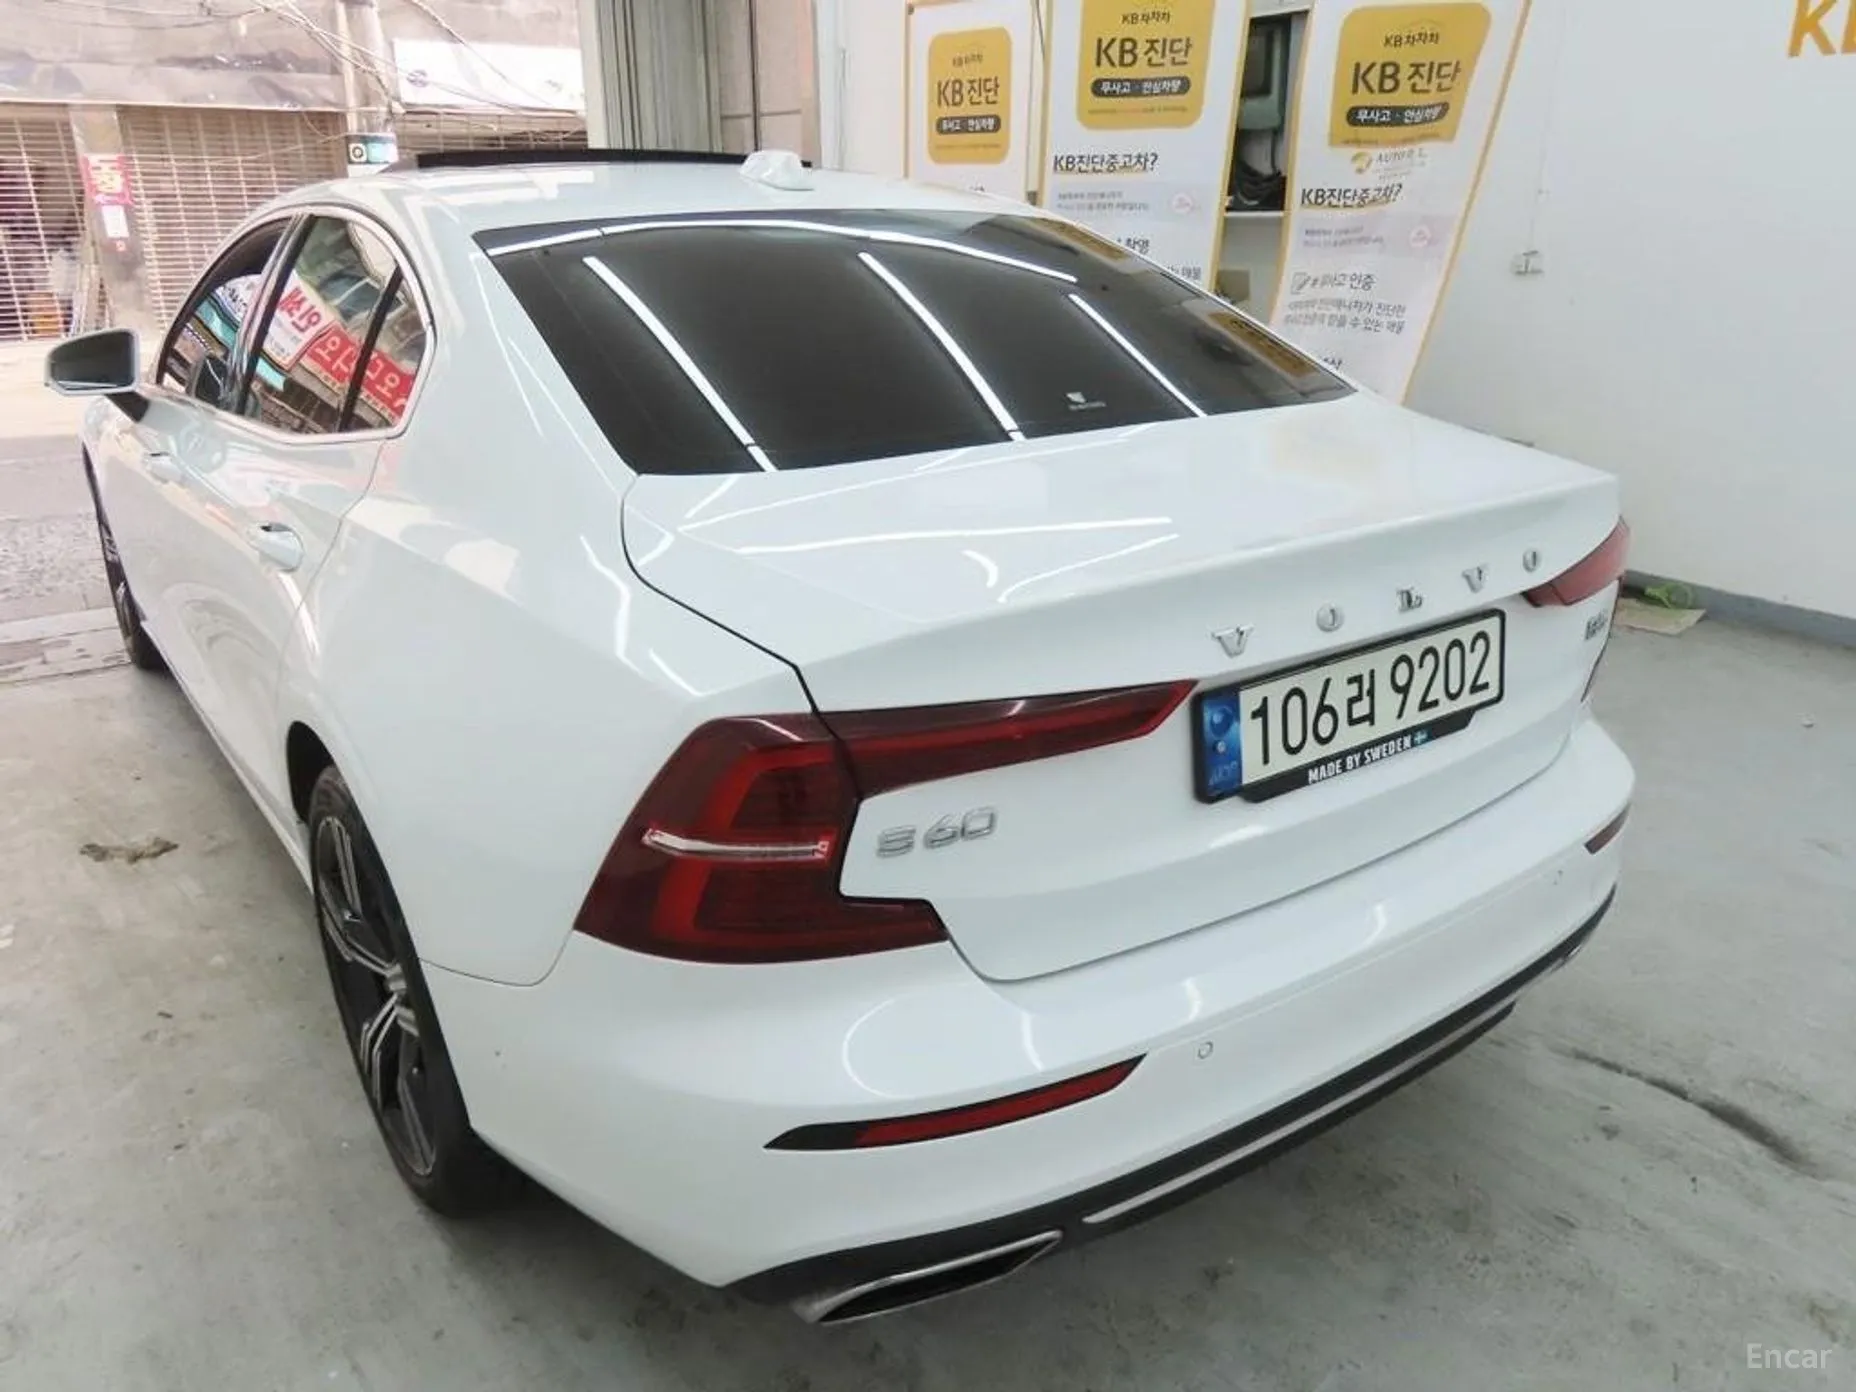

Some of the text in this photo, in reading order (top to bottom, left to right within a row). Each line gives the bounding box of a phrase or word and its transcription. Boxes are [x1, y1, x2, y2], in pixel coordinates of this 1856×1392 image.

[1095, 36, 1193, 68] KB 진단
[937, 75, 1000, 107] KB 진단
[1101, 81, 1132, 95] 무사고
[1351, 60, 1462, 95] KB 진단
[1356, 108, 1392, 123] 무사고
[1053, 152, 1158, 174] KB진단중고차?
[1300, 183, 1403, 208] KB진단중고차?
[1211, 549, 1542, 658] VOLVO
[1250, 630, 1491, 767] 106러 9202
[1308, 734, 1412, 784] MADE BY SWEDEN
[875, 806, 998, 858] S60
